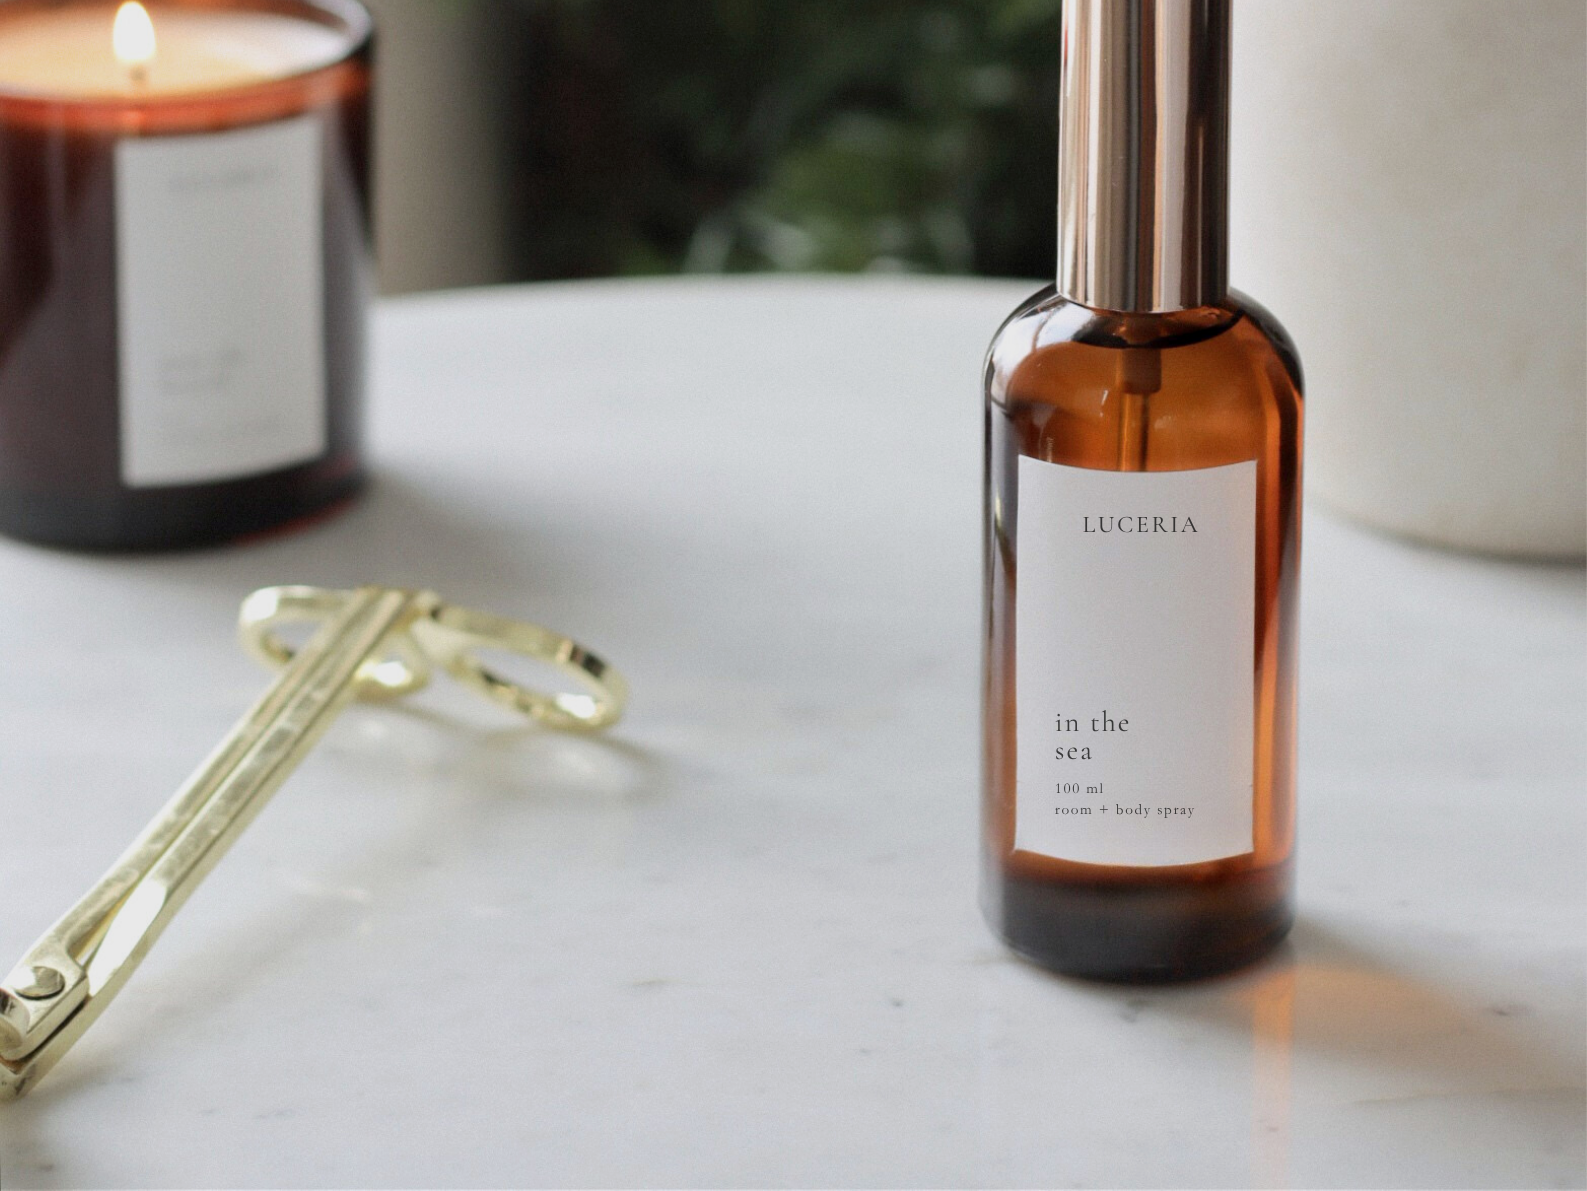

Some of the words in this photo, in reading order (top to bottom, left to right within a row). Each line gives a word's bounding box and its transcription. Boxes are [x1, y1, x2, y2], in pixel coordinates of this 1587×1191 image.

[1082, 516, 1199, 533] LUCERIA
[1055, 712, 1080, 732] in
[1091, 709, 1129, 732] the
[1055, 746, 1092, 761] sea
[1055, 782, 1080, 794] 100
[1086, 782, 1104, 794] ml
[1055, 806, 1092, 816] room
[1099, 805, 1109, 815] +
[1116, 803, 1151, 819] body
[1157, 806, 1195, 819] spray
